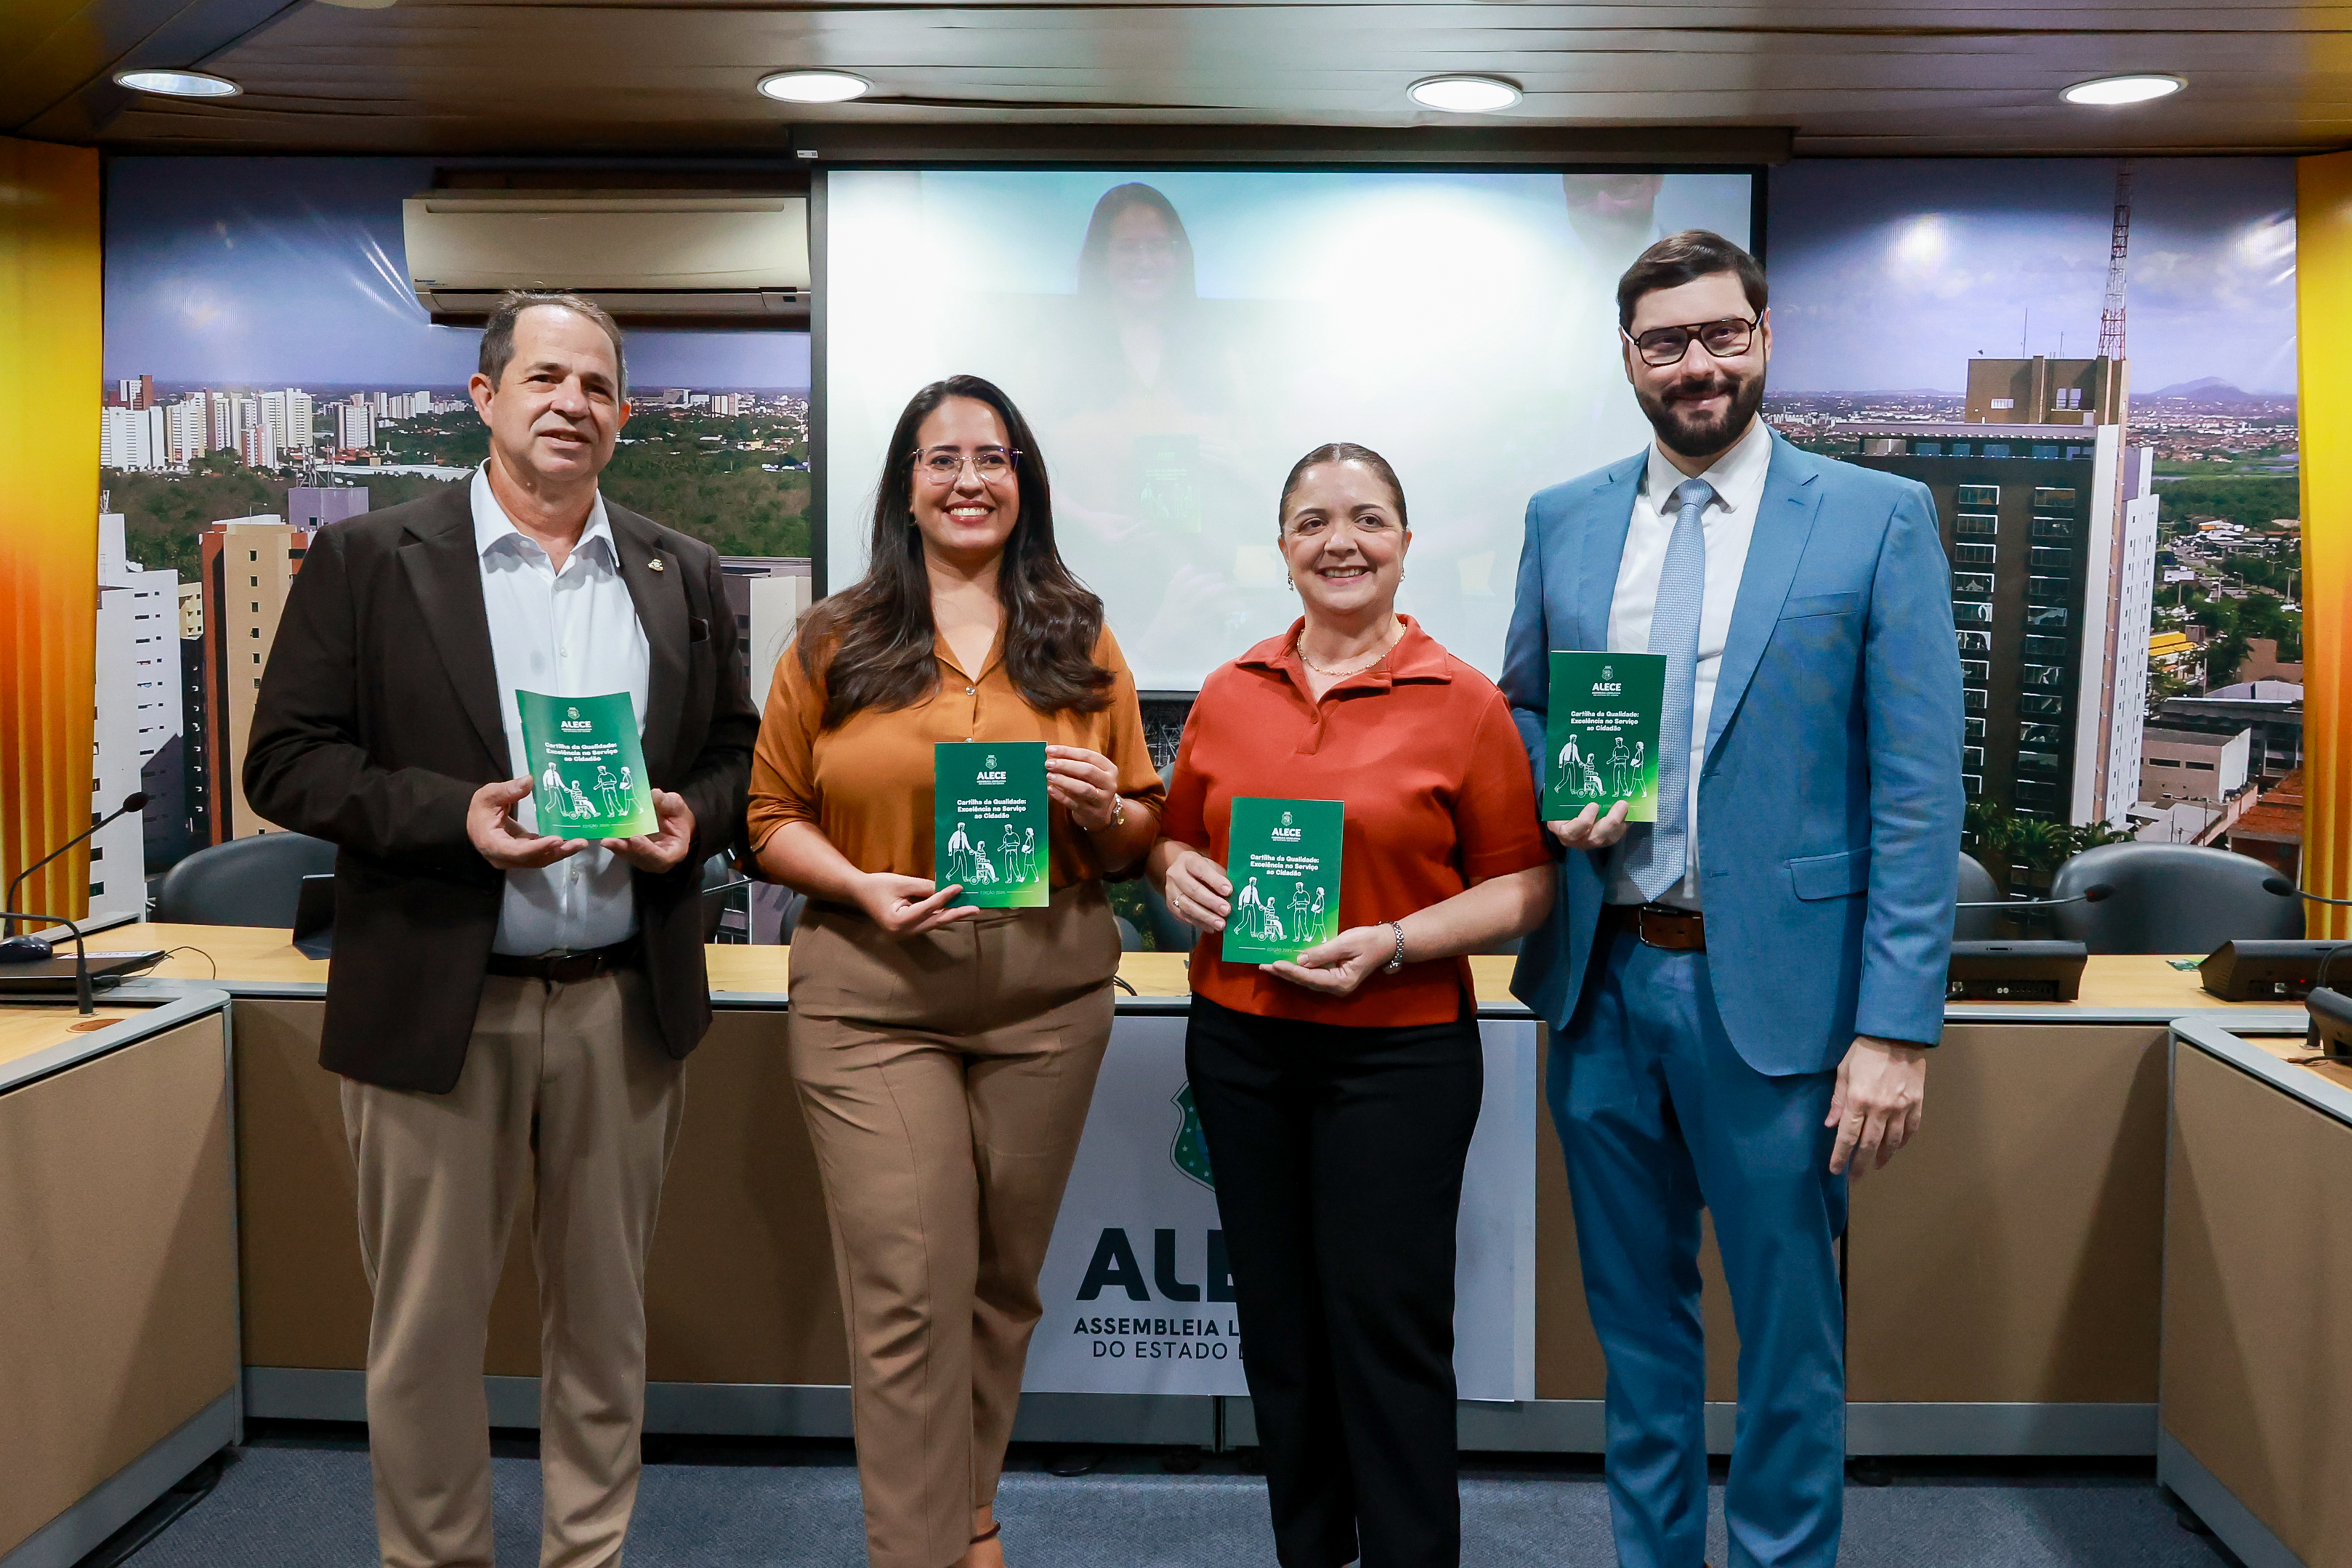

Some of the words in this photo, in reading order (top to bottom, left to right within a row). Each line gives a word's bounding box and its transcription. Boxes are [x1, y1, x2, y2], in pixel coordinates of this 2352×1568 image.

[1592, 682, 1622, 691] ALECE
[1272, 828, 1301, 837] ALECE
[1073, 1317, 1219, 1336] ASSEMBLEIA
[1093, 1341, 1125, 1358] DO
[1135, 1341, 1228, 1359] ESTADO
